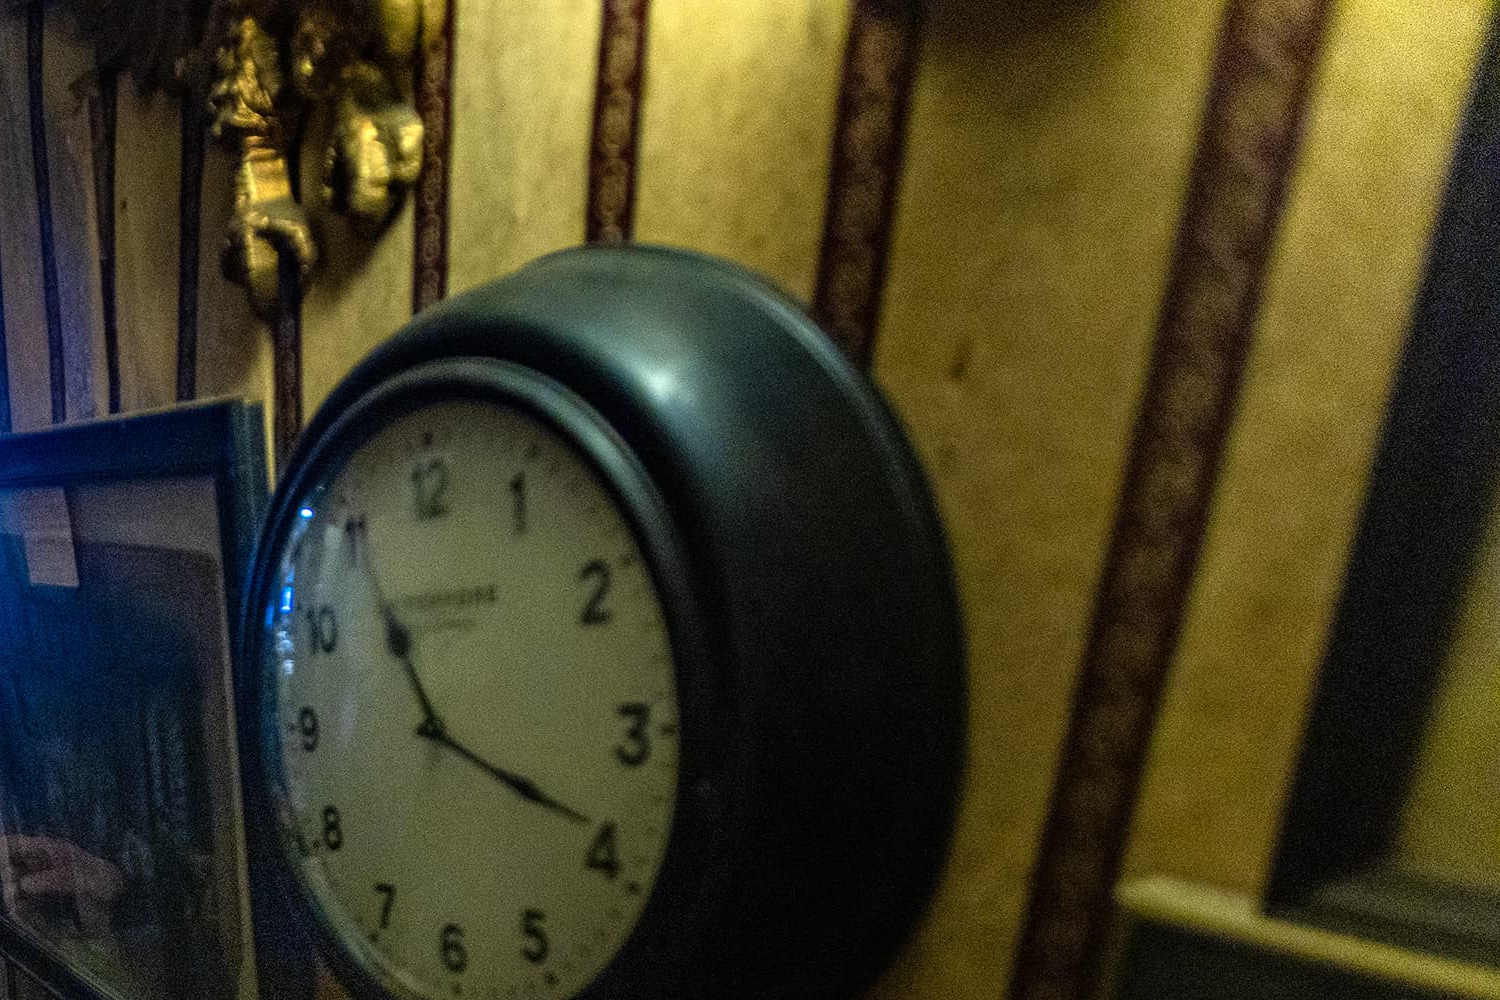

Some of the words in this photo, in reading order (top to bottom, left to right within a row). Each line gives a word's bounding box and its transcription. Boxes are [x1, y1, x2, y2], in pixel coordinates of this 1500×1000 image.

[509, 471, 526, 536] 1
[580, 560, 611, 627] 2
[306, 604, 339, 655] 10
[299, 706, 321, 753] 9
[615, 702, 651, 766] 3
[322, 804, 343, 851] 8
[585, 821, 621, 879] 4
[374, 882, 396, 930] 7
[440, 923, 468, 973] 6
[521, 907, 549, 964] 5
